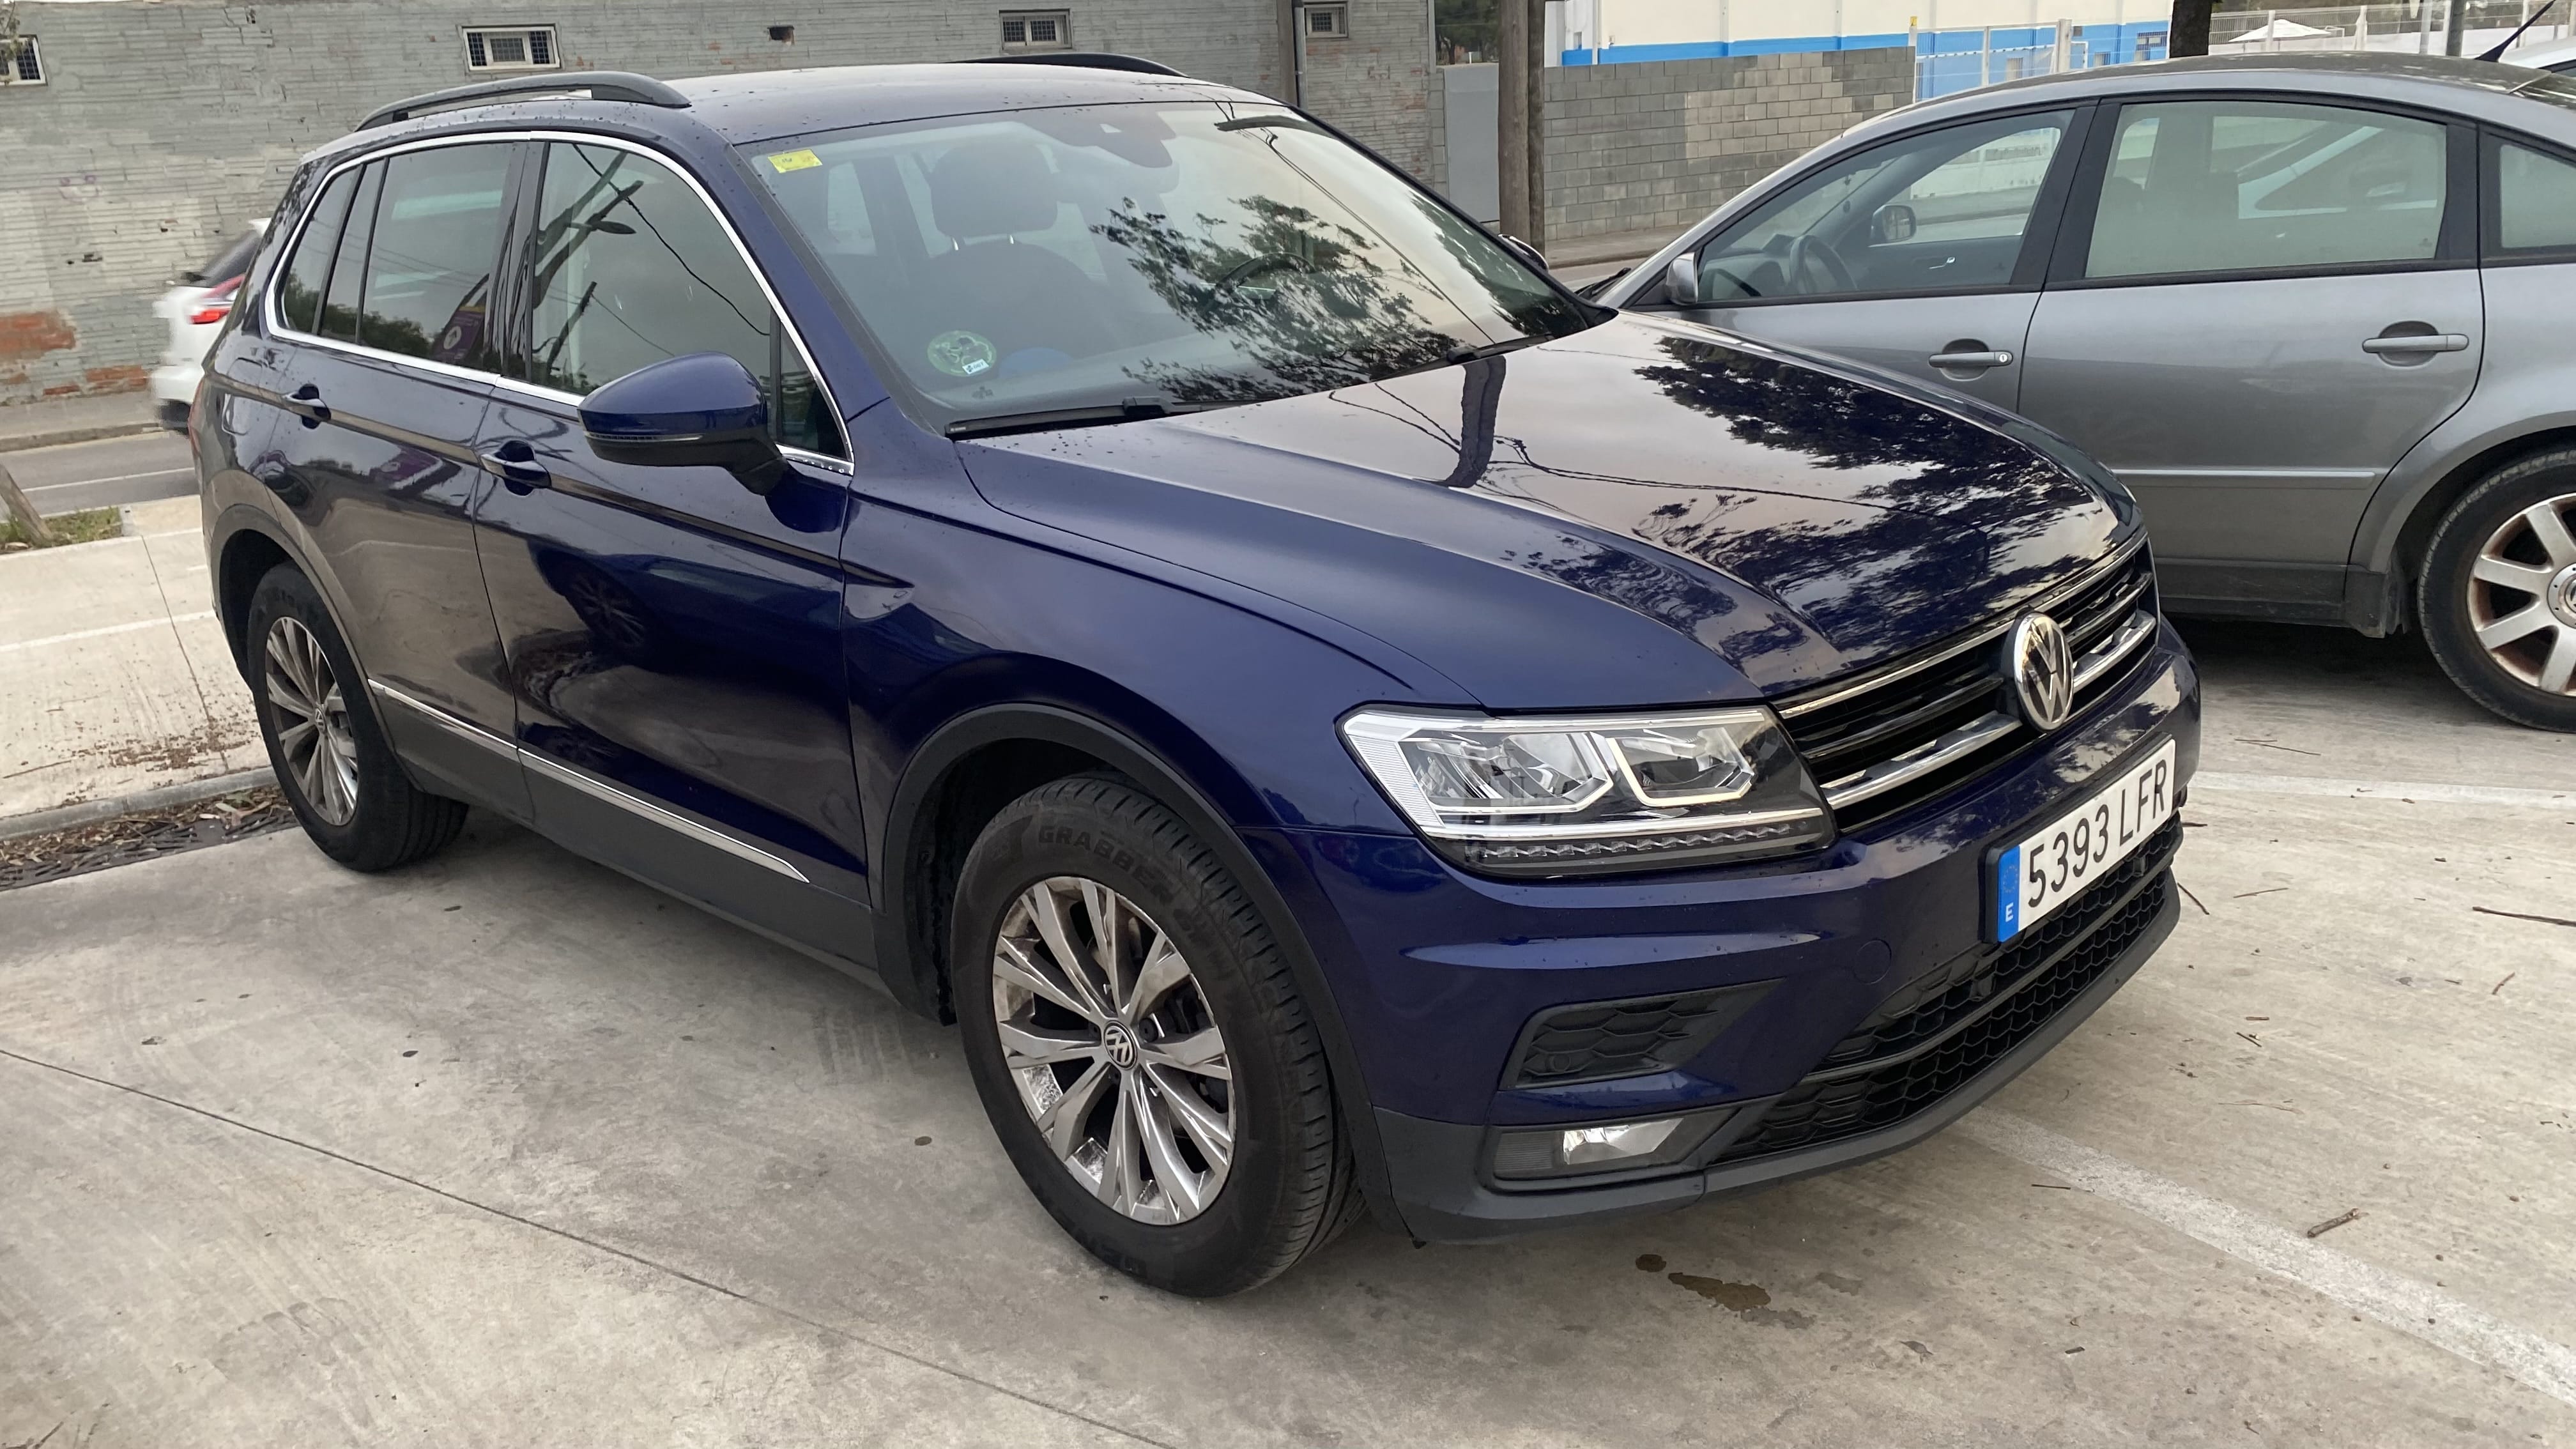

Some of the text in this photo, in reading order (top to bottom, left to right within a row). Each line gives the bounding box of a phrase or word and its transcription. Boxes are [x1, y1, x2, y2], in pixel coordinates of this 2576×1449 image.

[2028, 759, 2168, 908] 5393 LFR
[2005, 902, 2014, 923] E
